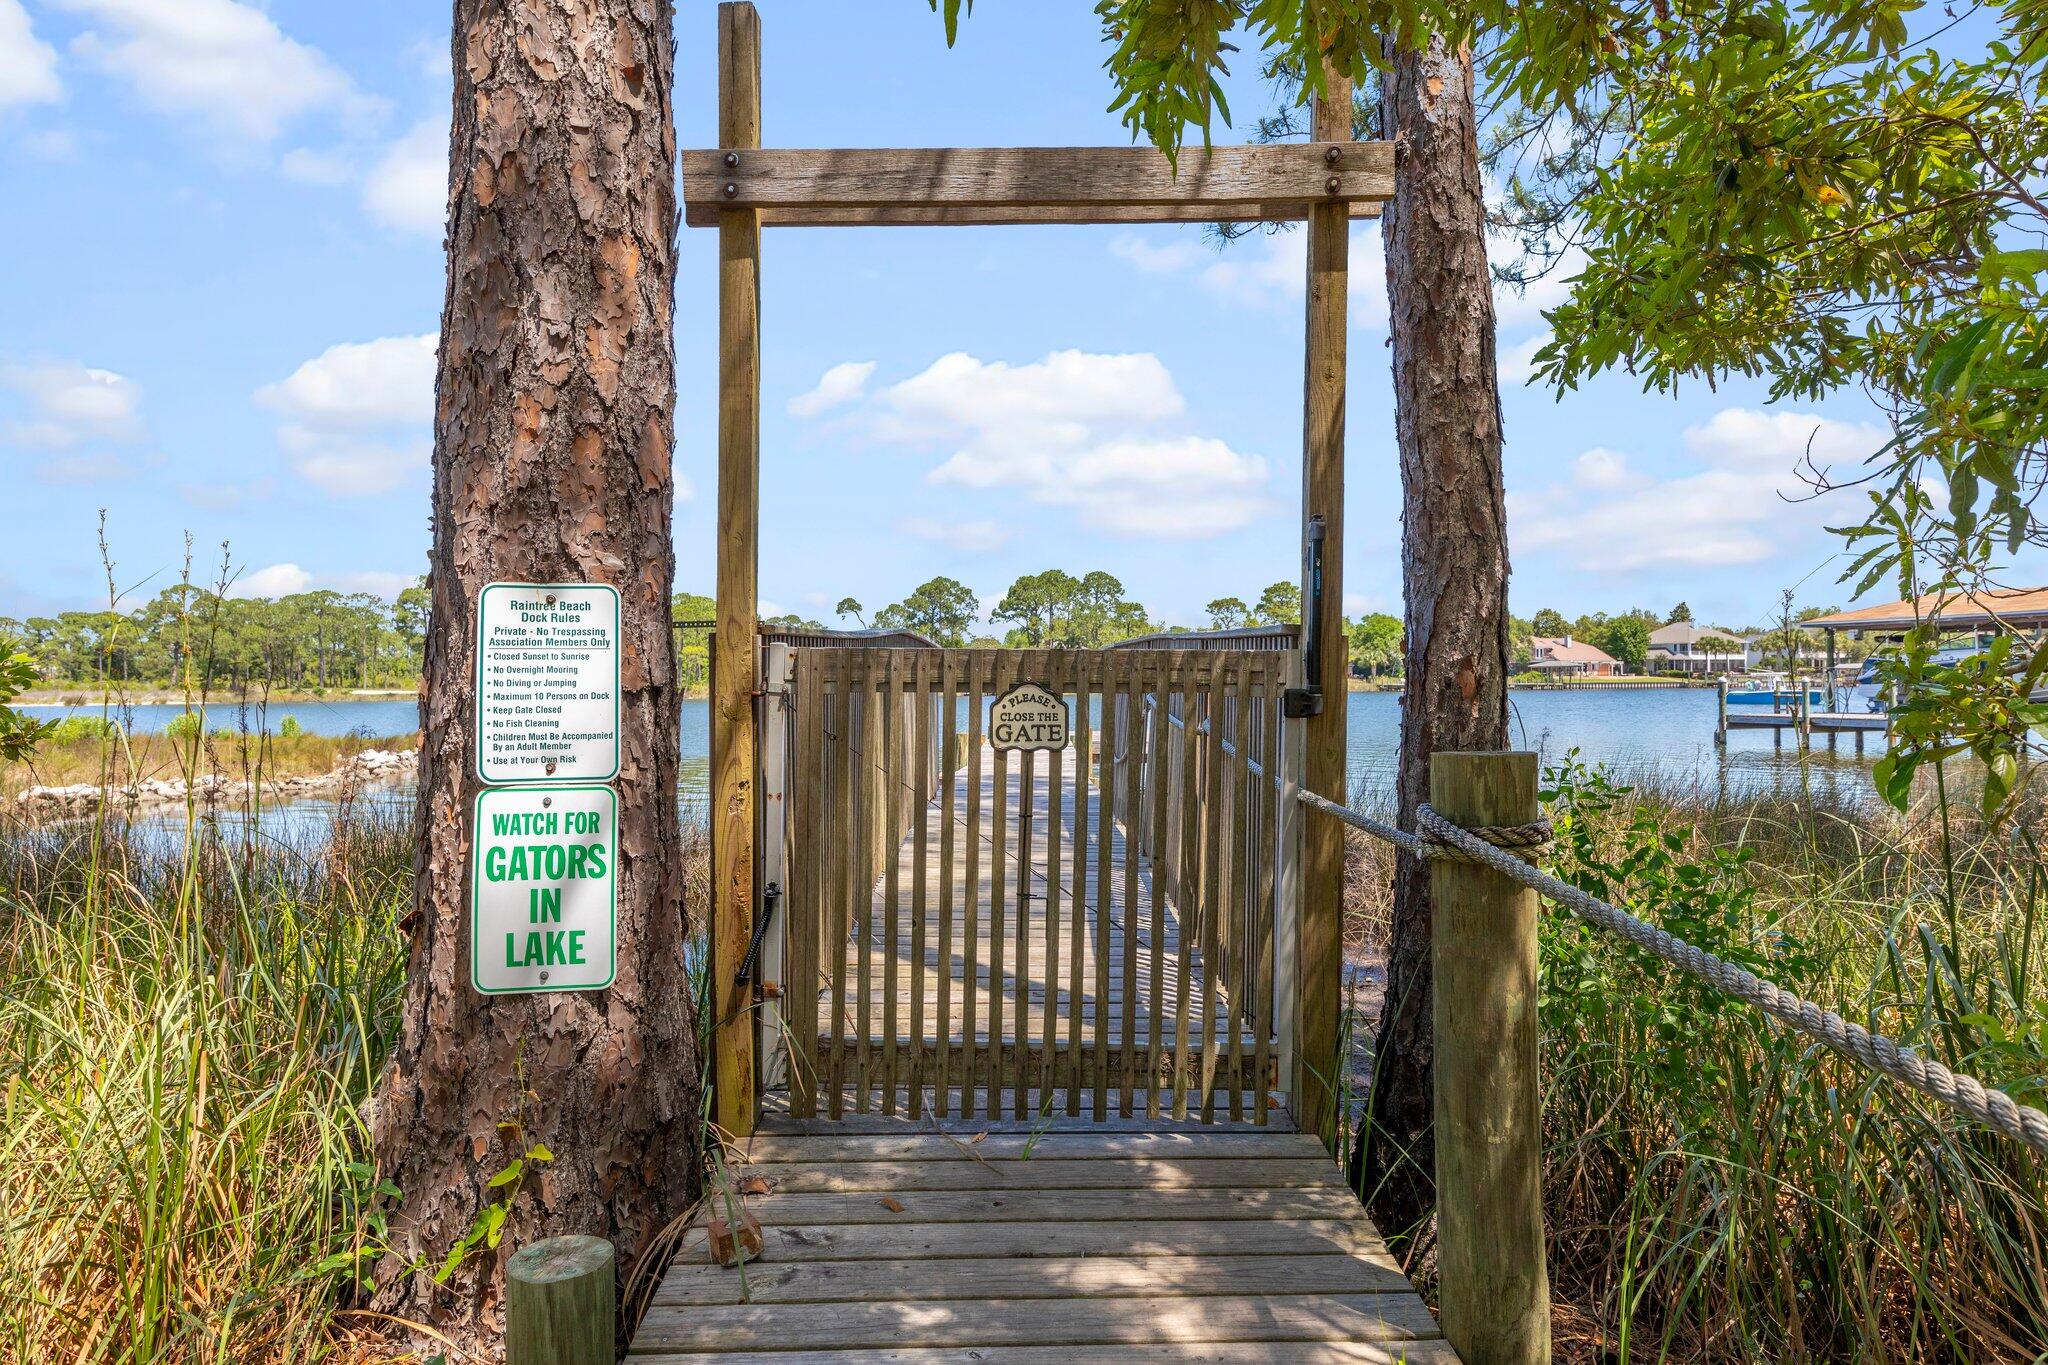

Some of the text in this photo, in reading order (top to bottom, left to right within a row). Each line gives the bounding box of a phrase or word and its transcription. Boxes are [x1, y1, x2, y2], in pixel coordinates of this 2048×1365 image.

[511, 601, 591, 611] Raintree Beach
[522, 613, 580, 622] Dock Rules
[495, 627, 526, 635] Private
[537, 628, 548, 636] No
[552, 628, 605, 637] Trespassing
[489, 638, 610, 648] Association Members Only
[507, 666, 544, 675] Overnight
[547, 666, 578, 674] Mooring
[493, 679, 503, 687] No
[506, 679, 531, 688] Diving
[544, 679, 577, 688] Jumping
[1008, 694, 1050, 707] PLEASE
[493, 707, 512, 715] Keep
[1000, 713, 1058, 721] CLOSE THE
[525, 720, 559, 728] Cleaning
[562, 732, 613, 741] Accompanied
[996, 724, 1062, 742] GATE
[493, 743, 502, 752] By
[493, 812, 599, 836] WATCH FOR
[486, 844, 606, 882] GATORS
[530, 888, 561, 923] IN
[506, 930, 585, 967] LAKE
